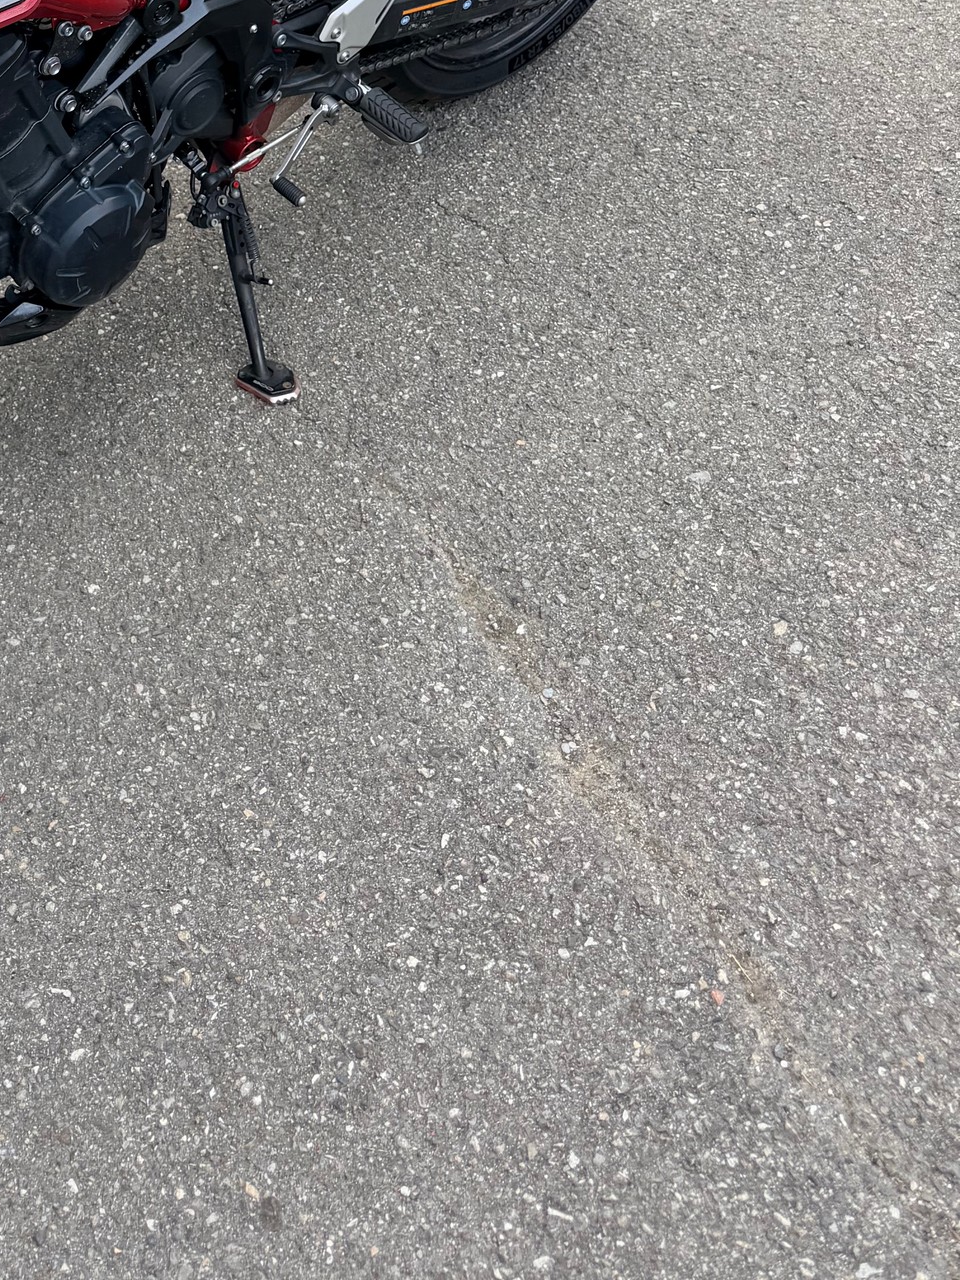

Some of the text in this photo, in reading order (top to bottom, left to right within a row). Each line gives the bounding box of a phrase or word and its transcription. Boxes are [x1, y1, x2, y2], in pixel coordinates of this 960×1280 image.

[513, 1, 588, 69] 180/55 ZR 17
